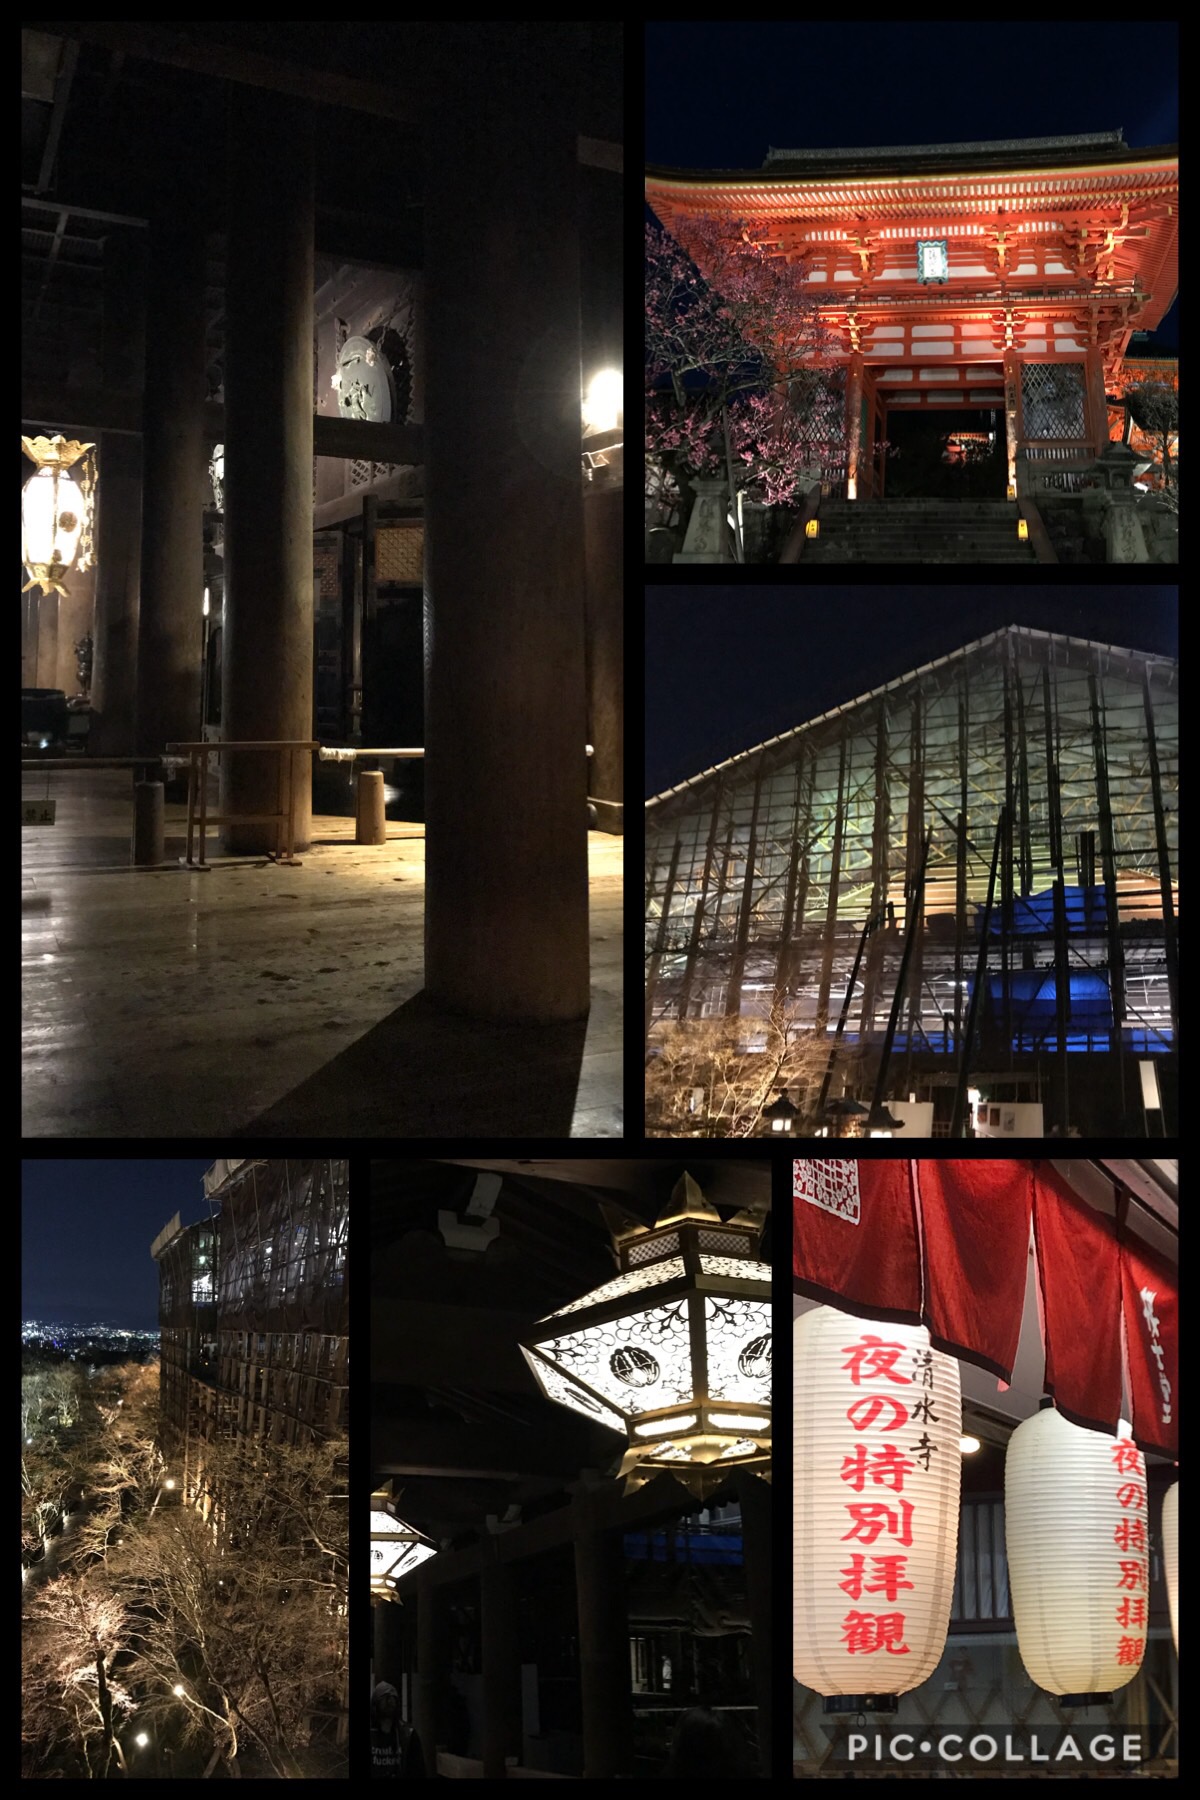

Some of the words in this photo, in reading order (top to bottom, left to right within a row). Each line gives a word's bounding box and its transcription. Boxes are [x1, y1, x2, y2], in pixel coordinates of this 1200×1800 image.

[22, 808, 51, 821] 禁止
[838, 1335, 915, 1655] 夜の特別拝観
[909, 1349, 940, 1472] 清水寺
[1110, 1438, 1148, 1666] 夜の特別拝観
